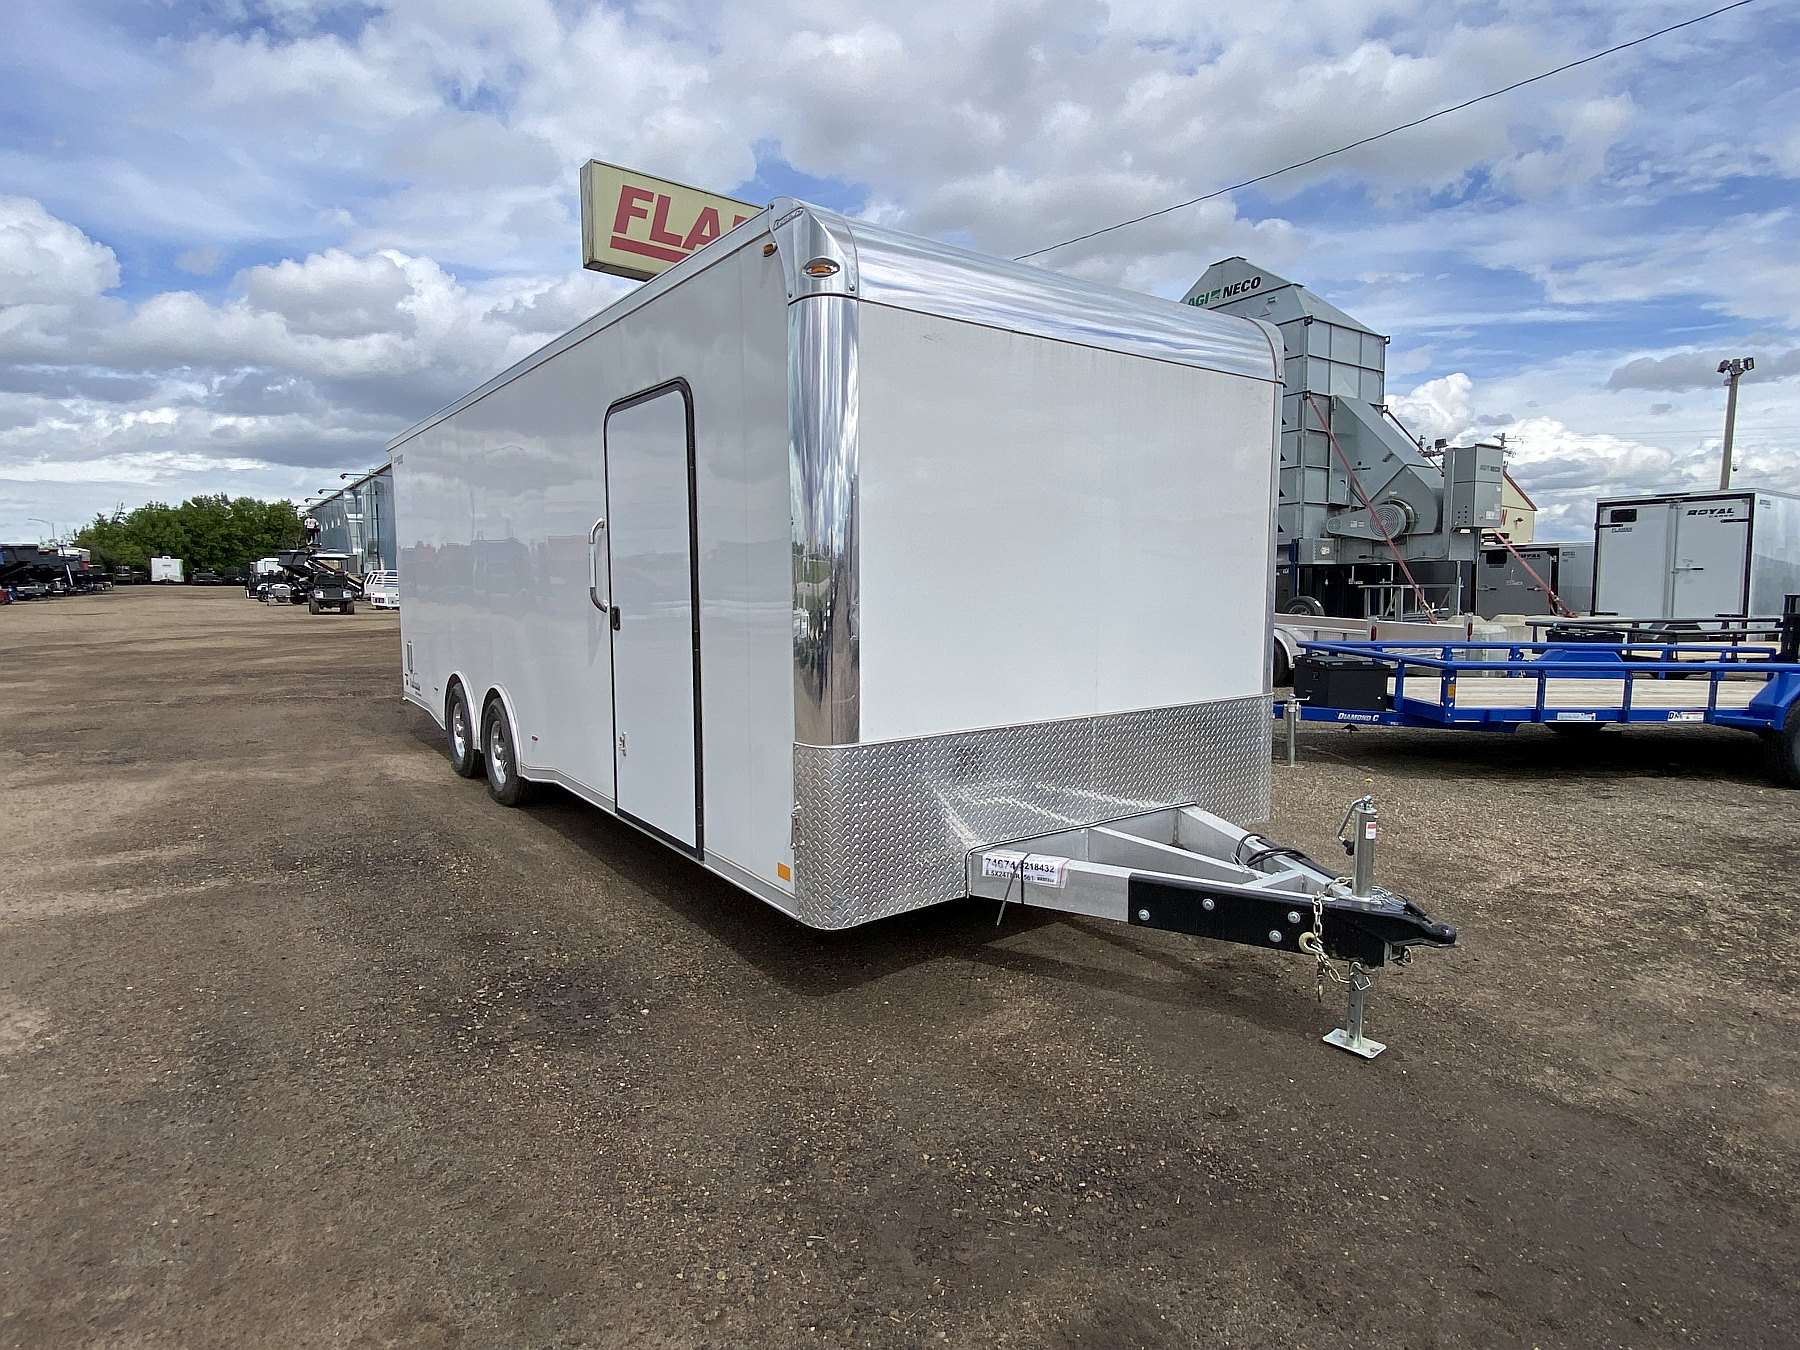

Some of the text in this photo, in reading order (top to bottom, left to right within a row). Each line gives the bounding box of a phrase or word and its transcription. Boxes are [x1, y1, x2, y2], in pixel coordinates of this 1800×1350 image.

[613, 185, 748, 250] FLA
[1222, 276, 1262, 298] NECO
[1687, 507, 1735, 516] ROYAL
[1338, 712, 1380, 722] DIAMOND C
